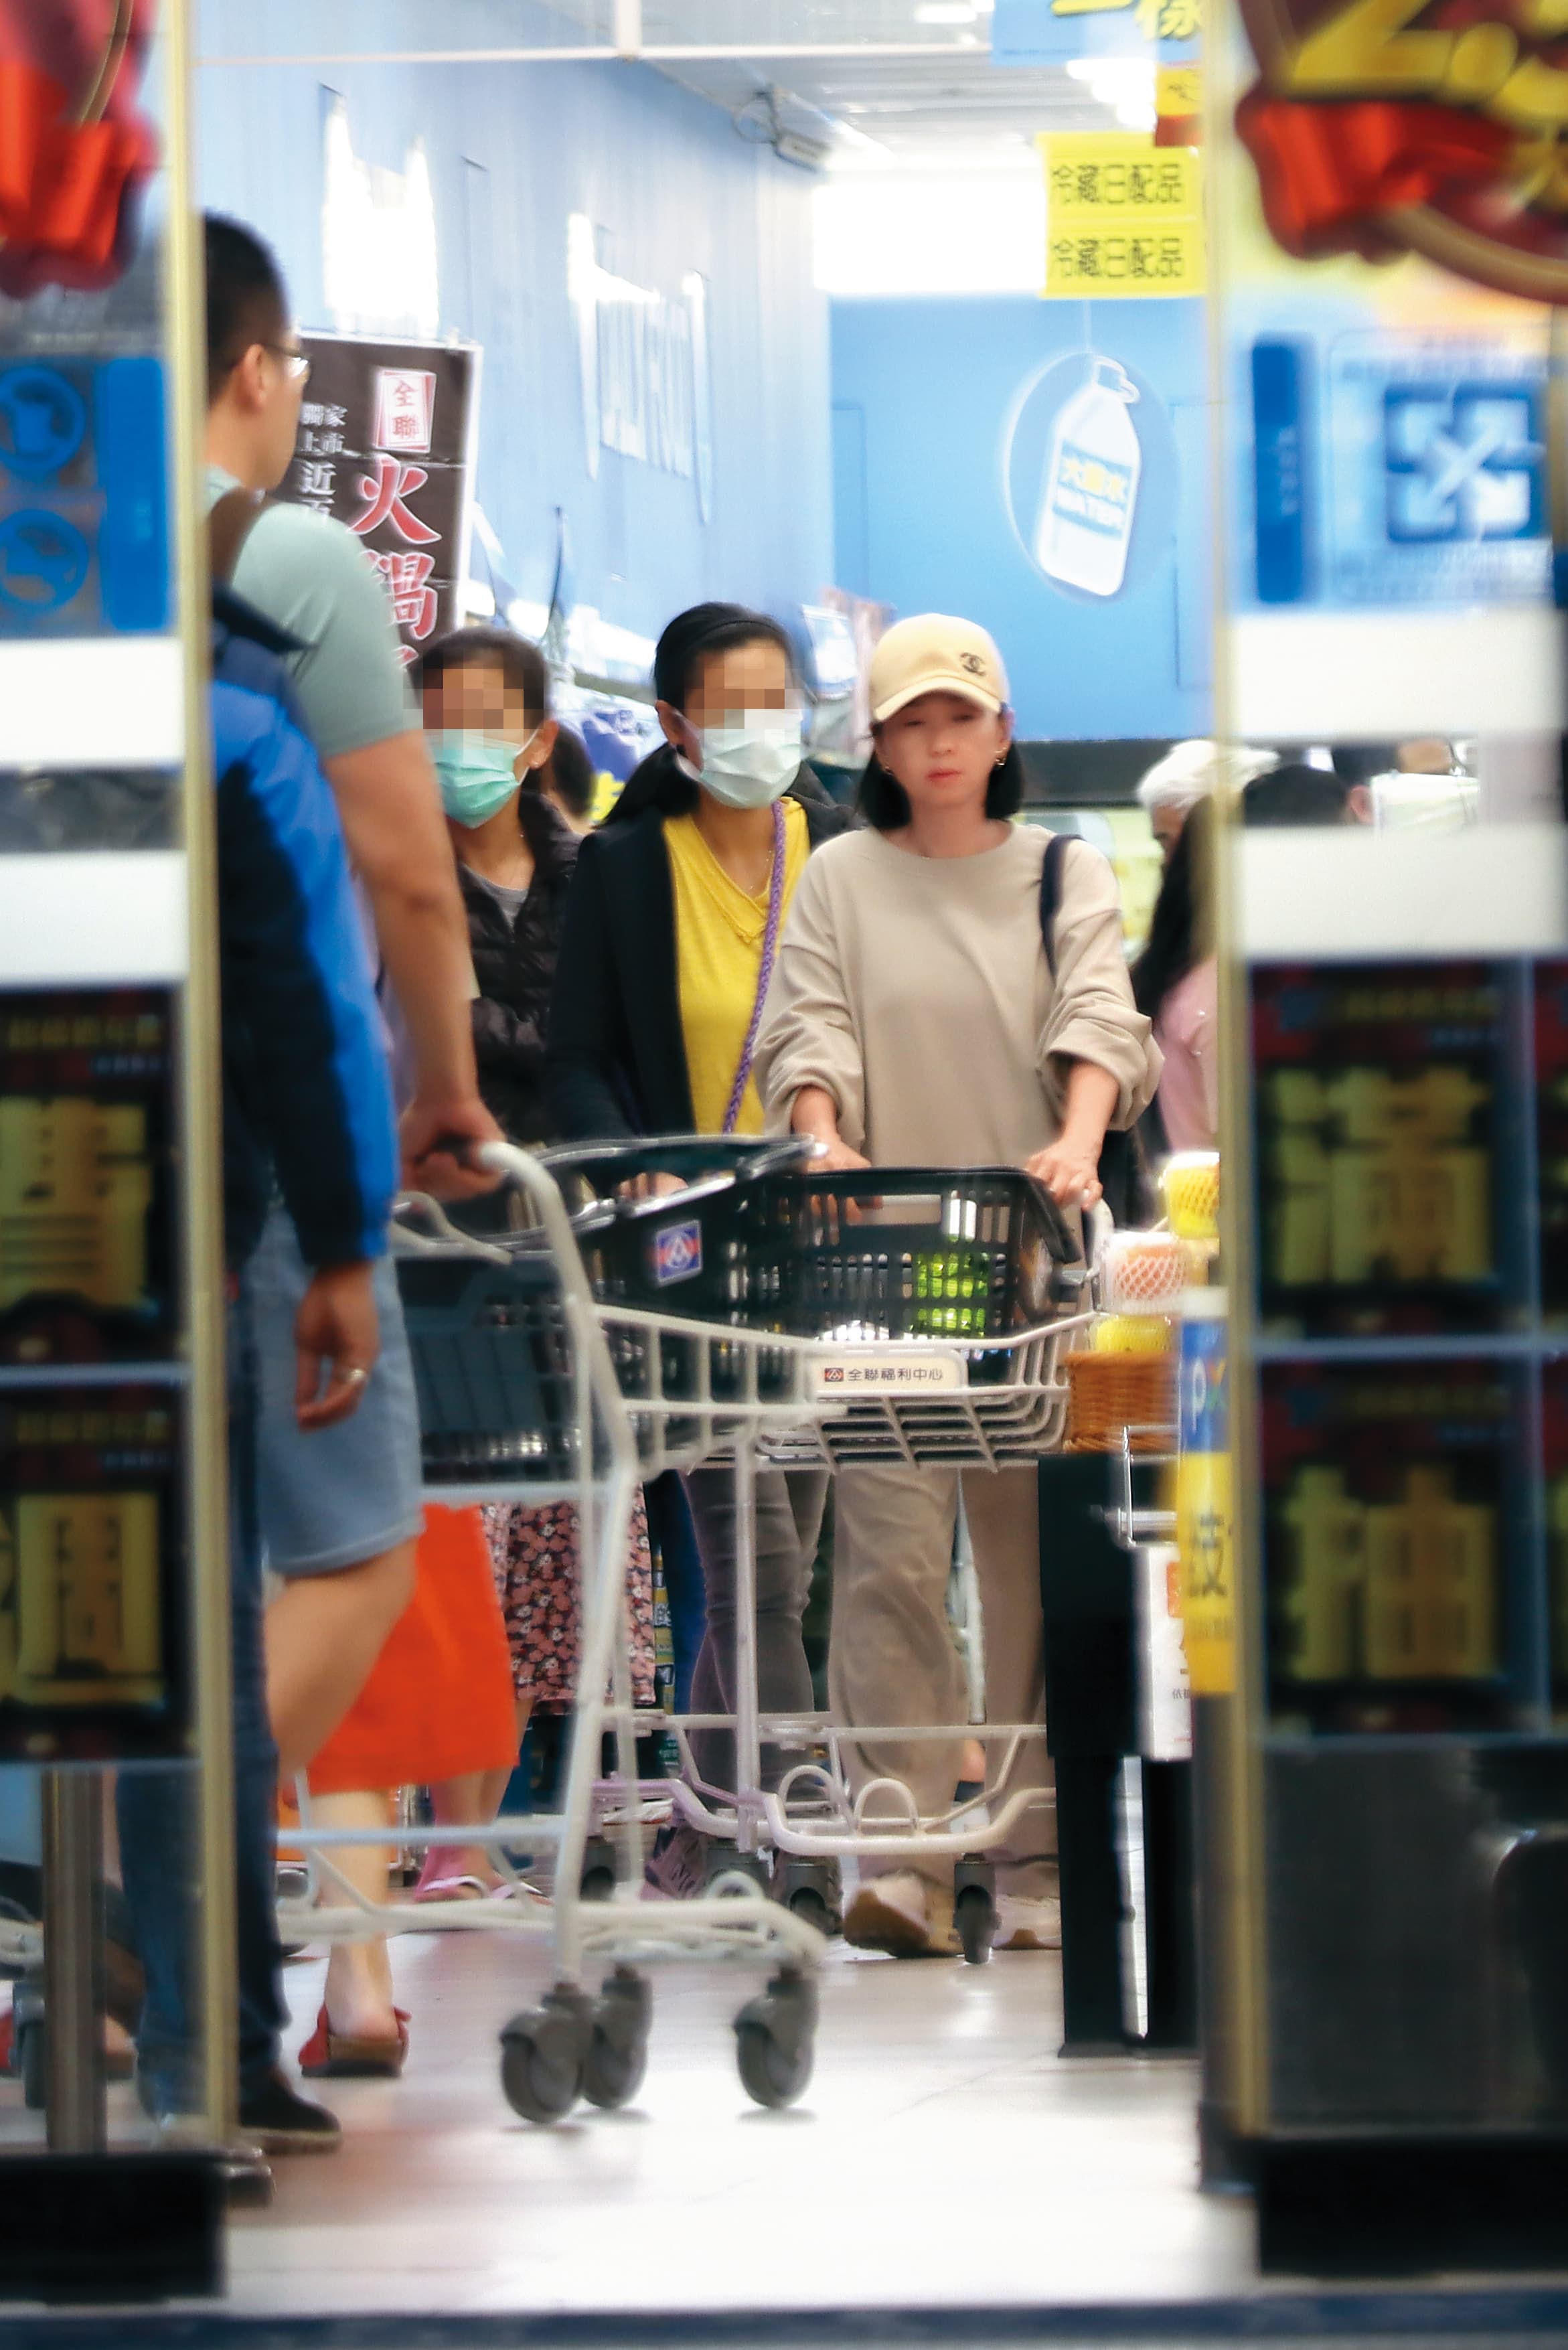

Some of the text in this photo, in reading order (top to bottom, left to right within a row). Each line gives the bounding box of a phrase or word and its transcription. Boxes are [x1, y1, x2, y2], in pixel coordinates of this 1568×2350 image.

[1052, 163, 1183, 204] 冷藏日配品
[1052, 238, 1183, 278] 冷藏日配品
[392, 380, 420, 439] 全聯
[347, 452, 443, 670] 火鍋
[848, 1367, 943, 1381] 全聯福利中心
